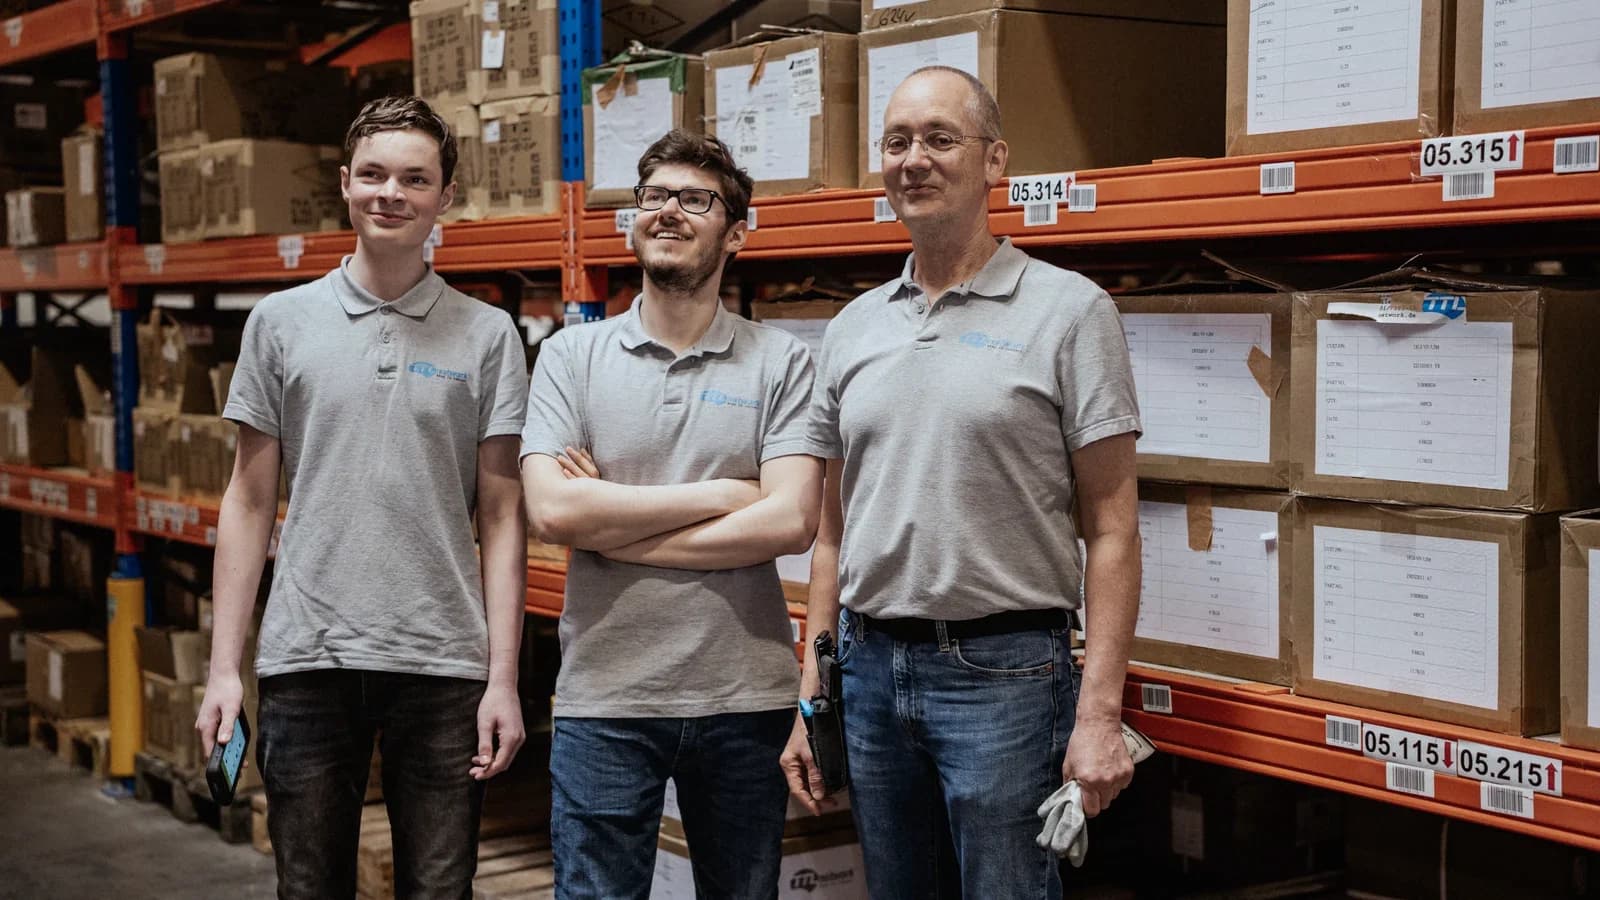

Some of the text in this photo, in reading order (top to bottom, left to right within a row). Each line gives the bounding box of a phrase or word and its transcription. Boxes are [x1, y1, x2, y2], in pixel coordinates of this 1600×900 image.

[1424, 138, 1504, 167] 05.315
[1011, 180, 1063, 202] 05.314
[1423, 296, 1466, 311] TTL
[1365, 730, 1439, 766] 05.115
[1460, 749, 1542, 787] 05.215
